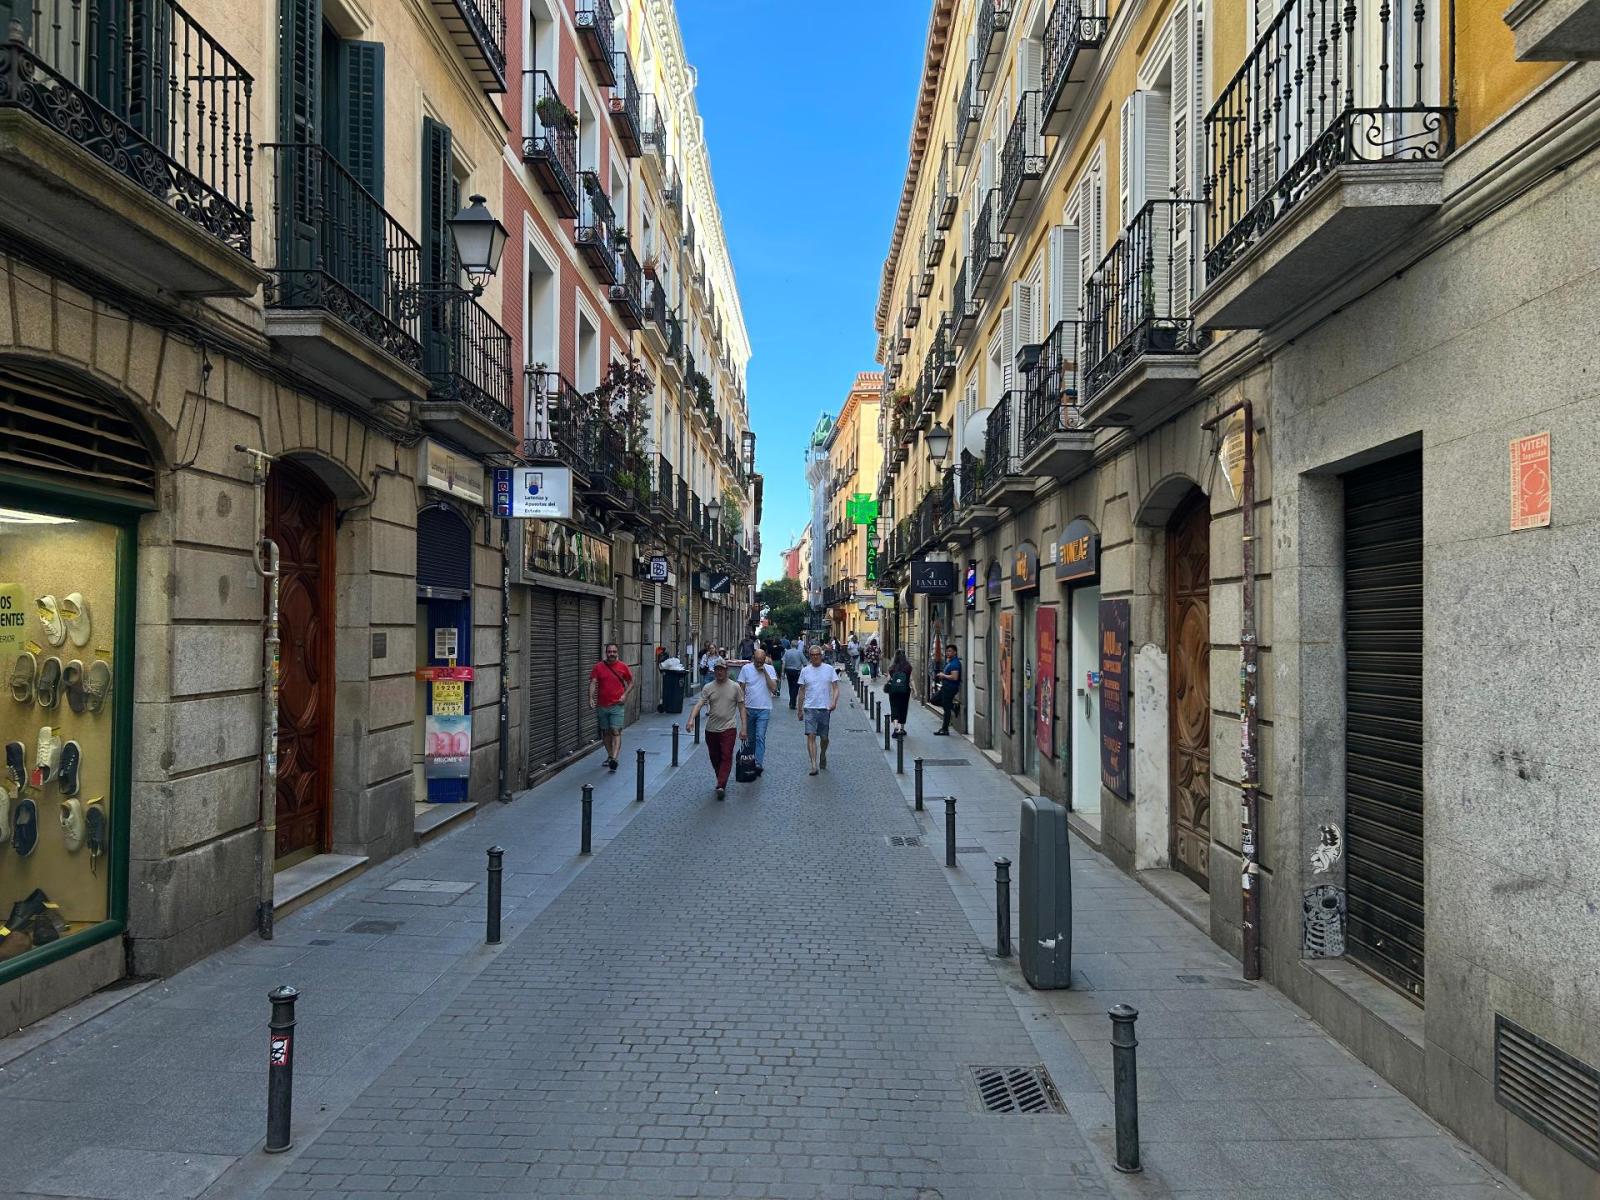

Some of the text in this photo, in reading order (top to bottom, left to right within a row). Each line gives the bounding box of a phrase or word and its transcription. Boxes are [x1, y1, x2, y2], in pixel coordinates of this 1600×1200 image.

[1520, 436, 1548, 451] VITEN
[0, 596, 11, 609] OS
[0, 613, 24, 627] ENTES
